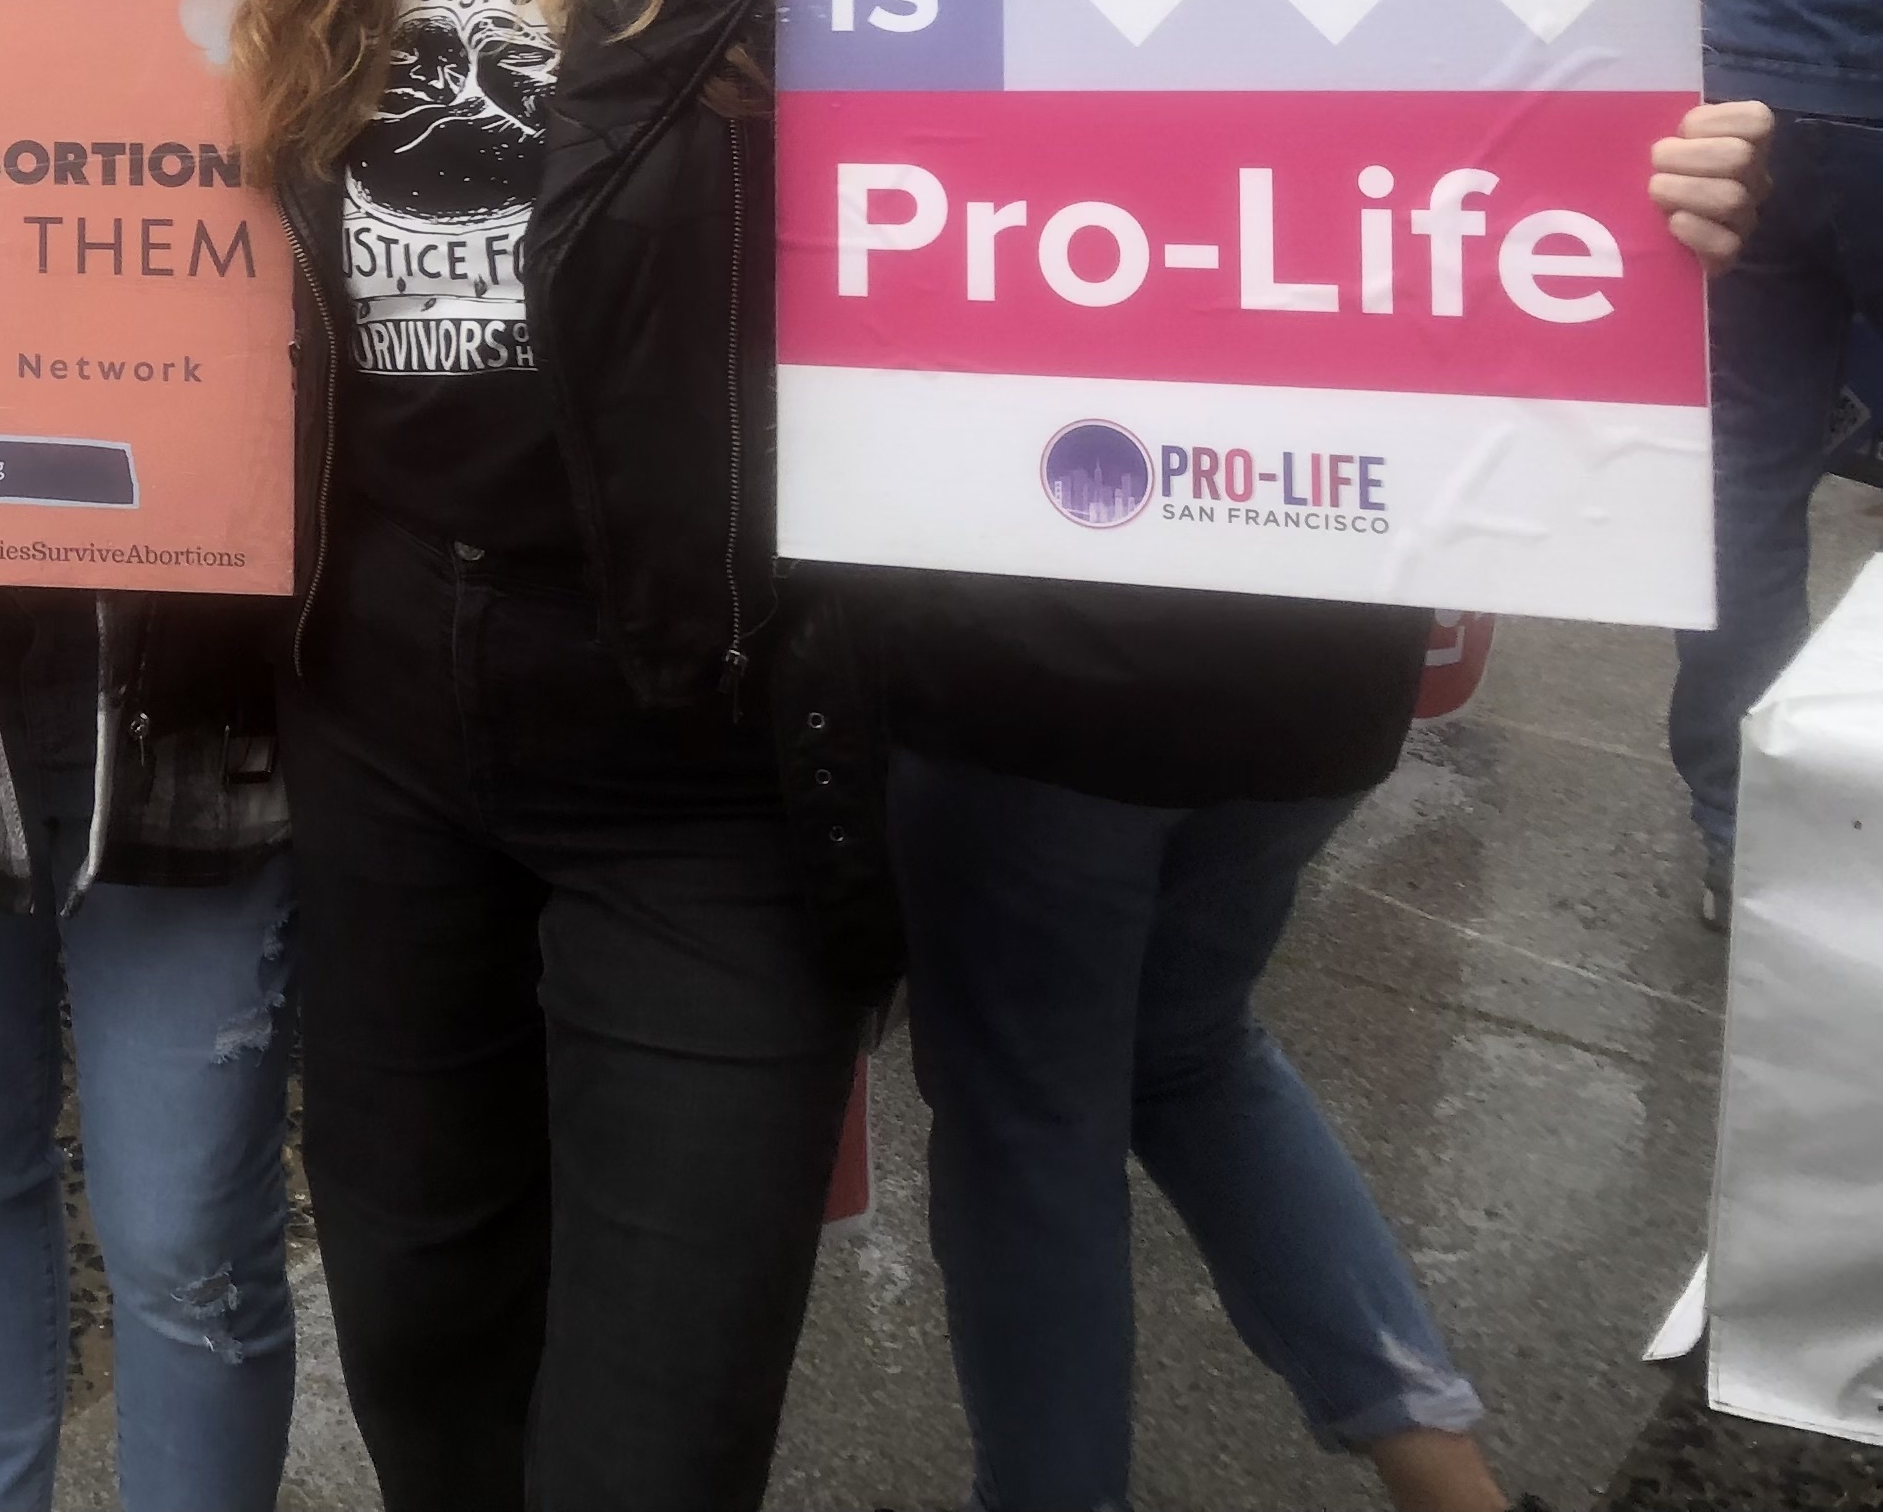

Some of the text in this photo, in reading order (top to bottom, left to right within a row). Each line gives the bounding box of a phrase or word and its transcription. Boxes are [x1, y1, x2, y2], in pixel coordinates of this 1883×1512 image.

[25, 216, 257, 278] THEM
[837, 163, 1624, 324] Pro-Life
[18, 352, 203, 383] Network
[355, 320, 509, 371] URVIVORS
[1161, 444, 1389, 512] PRO-LIFE
[1162, 503, 1390, 535] SAN FRANCISCO
